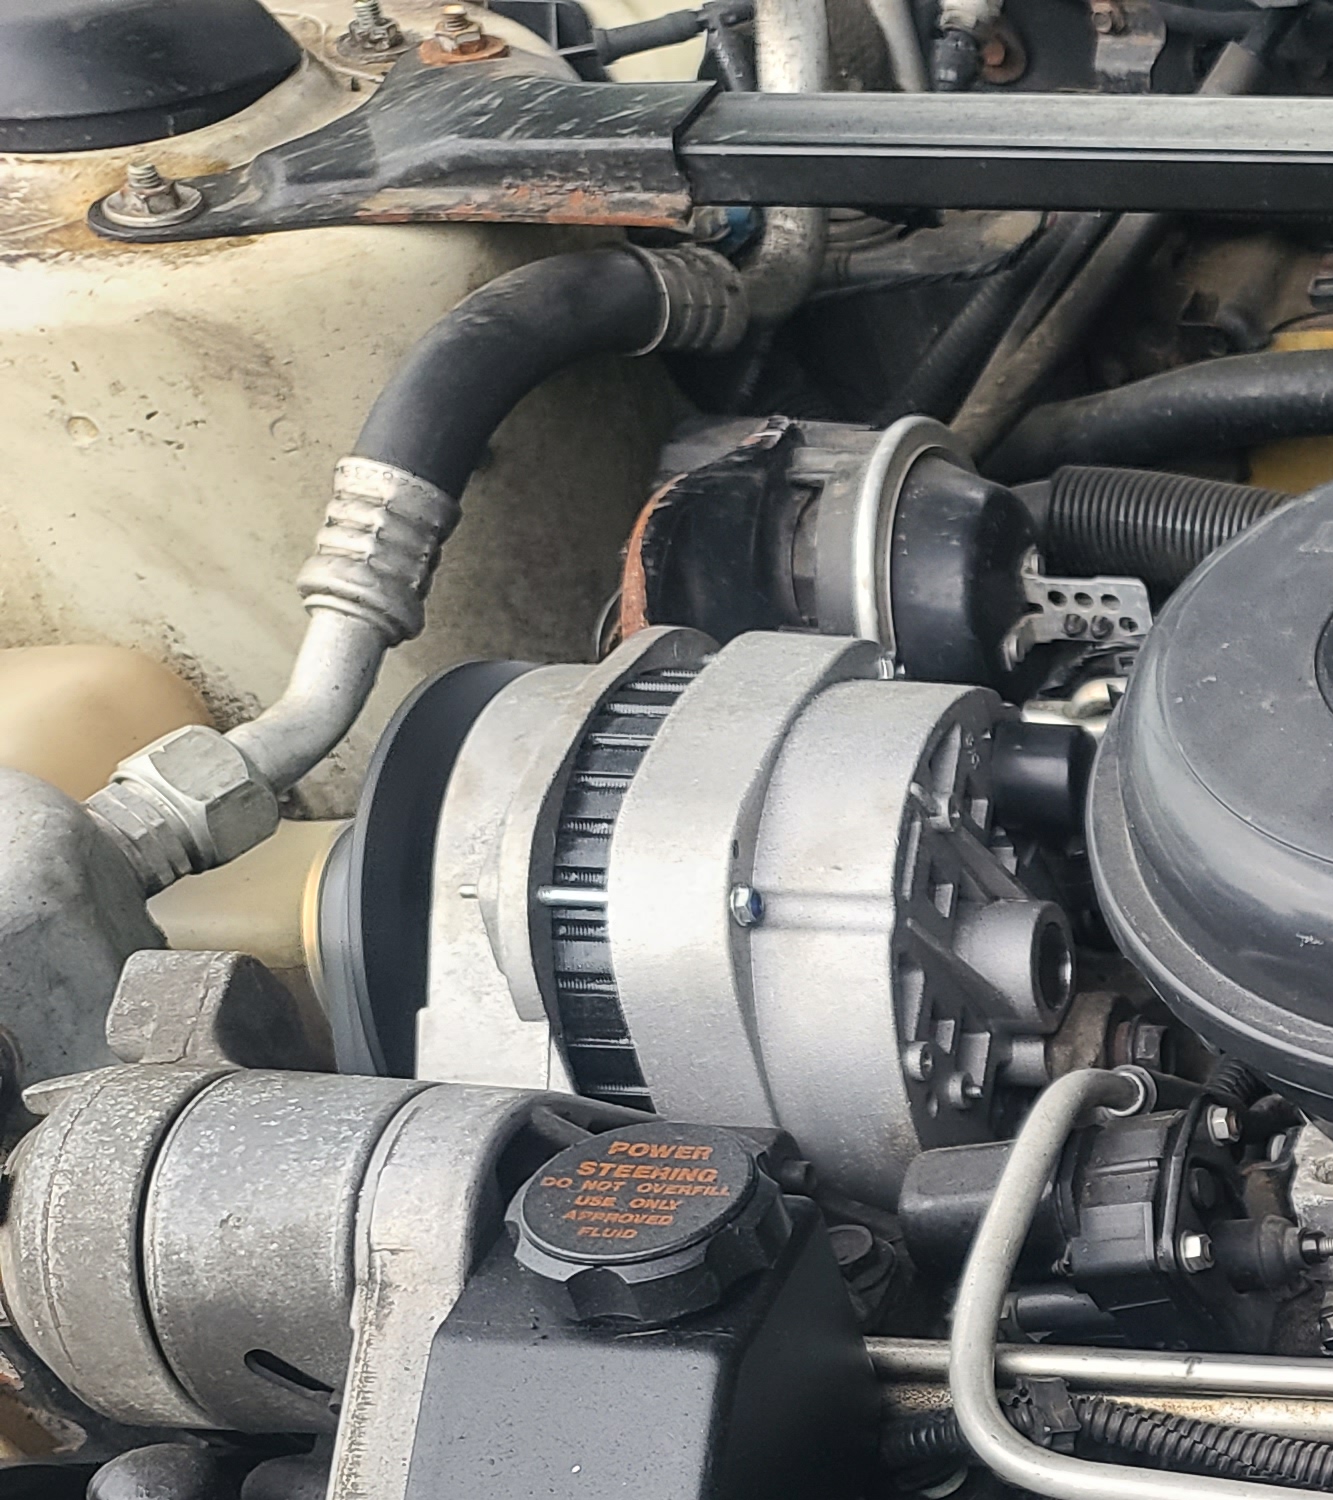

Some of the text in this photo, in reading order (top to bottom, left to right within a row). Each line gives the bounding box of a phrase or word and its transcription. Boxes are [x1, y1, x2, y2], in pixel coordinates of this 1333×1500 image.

[607, 1141, 713, 1160] POWER
[577, 1161, 718, 1182] STEERING
[540, 1177, 731, 1196] DO NOT OVERFILL
[574, 1195, 682, 1210] USE ONLY
[562, 1210, 674, 1226] APPROVED
[577, 1227, 638, 1239] FLUID
